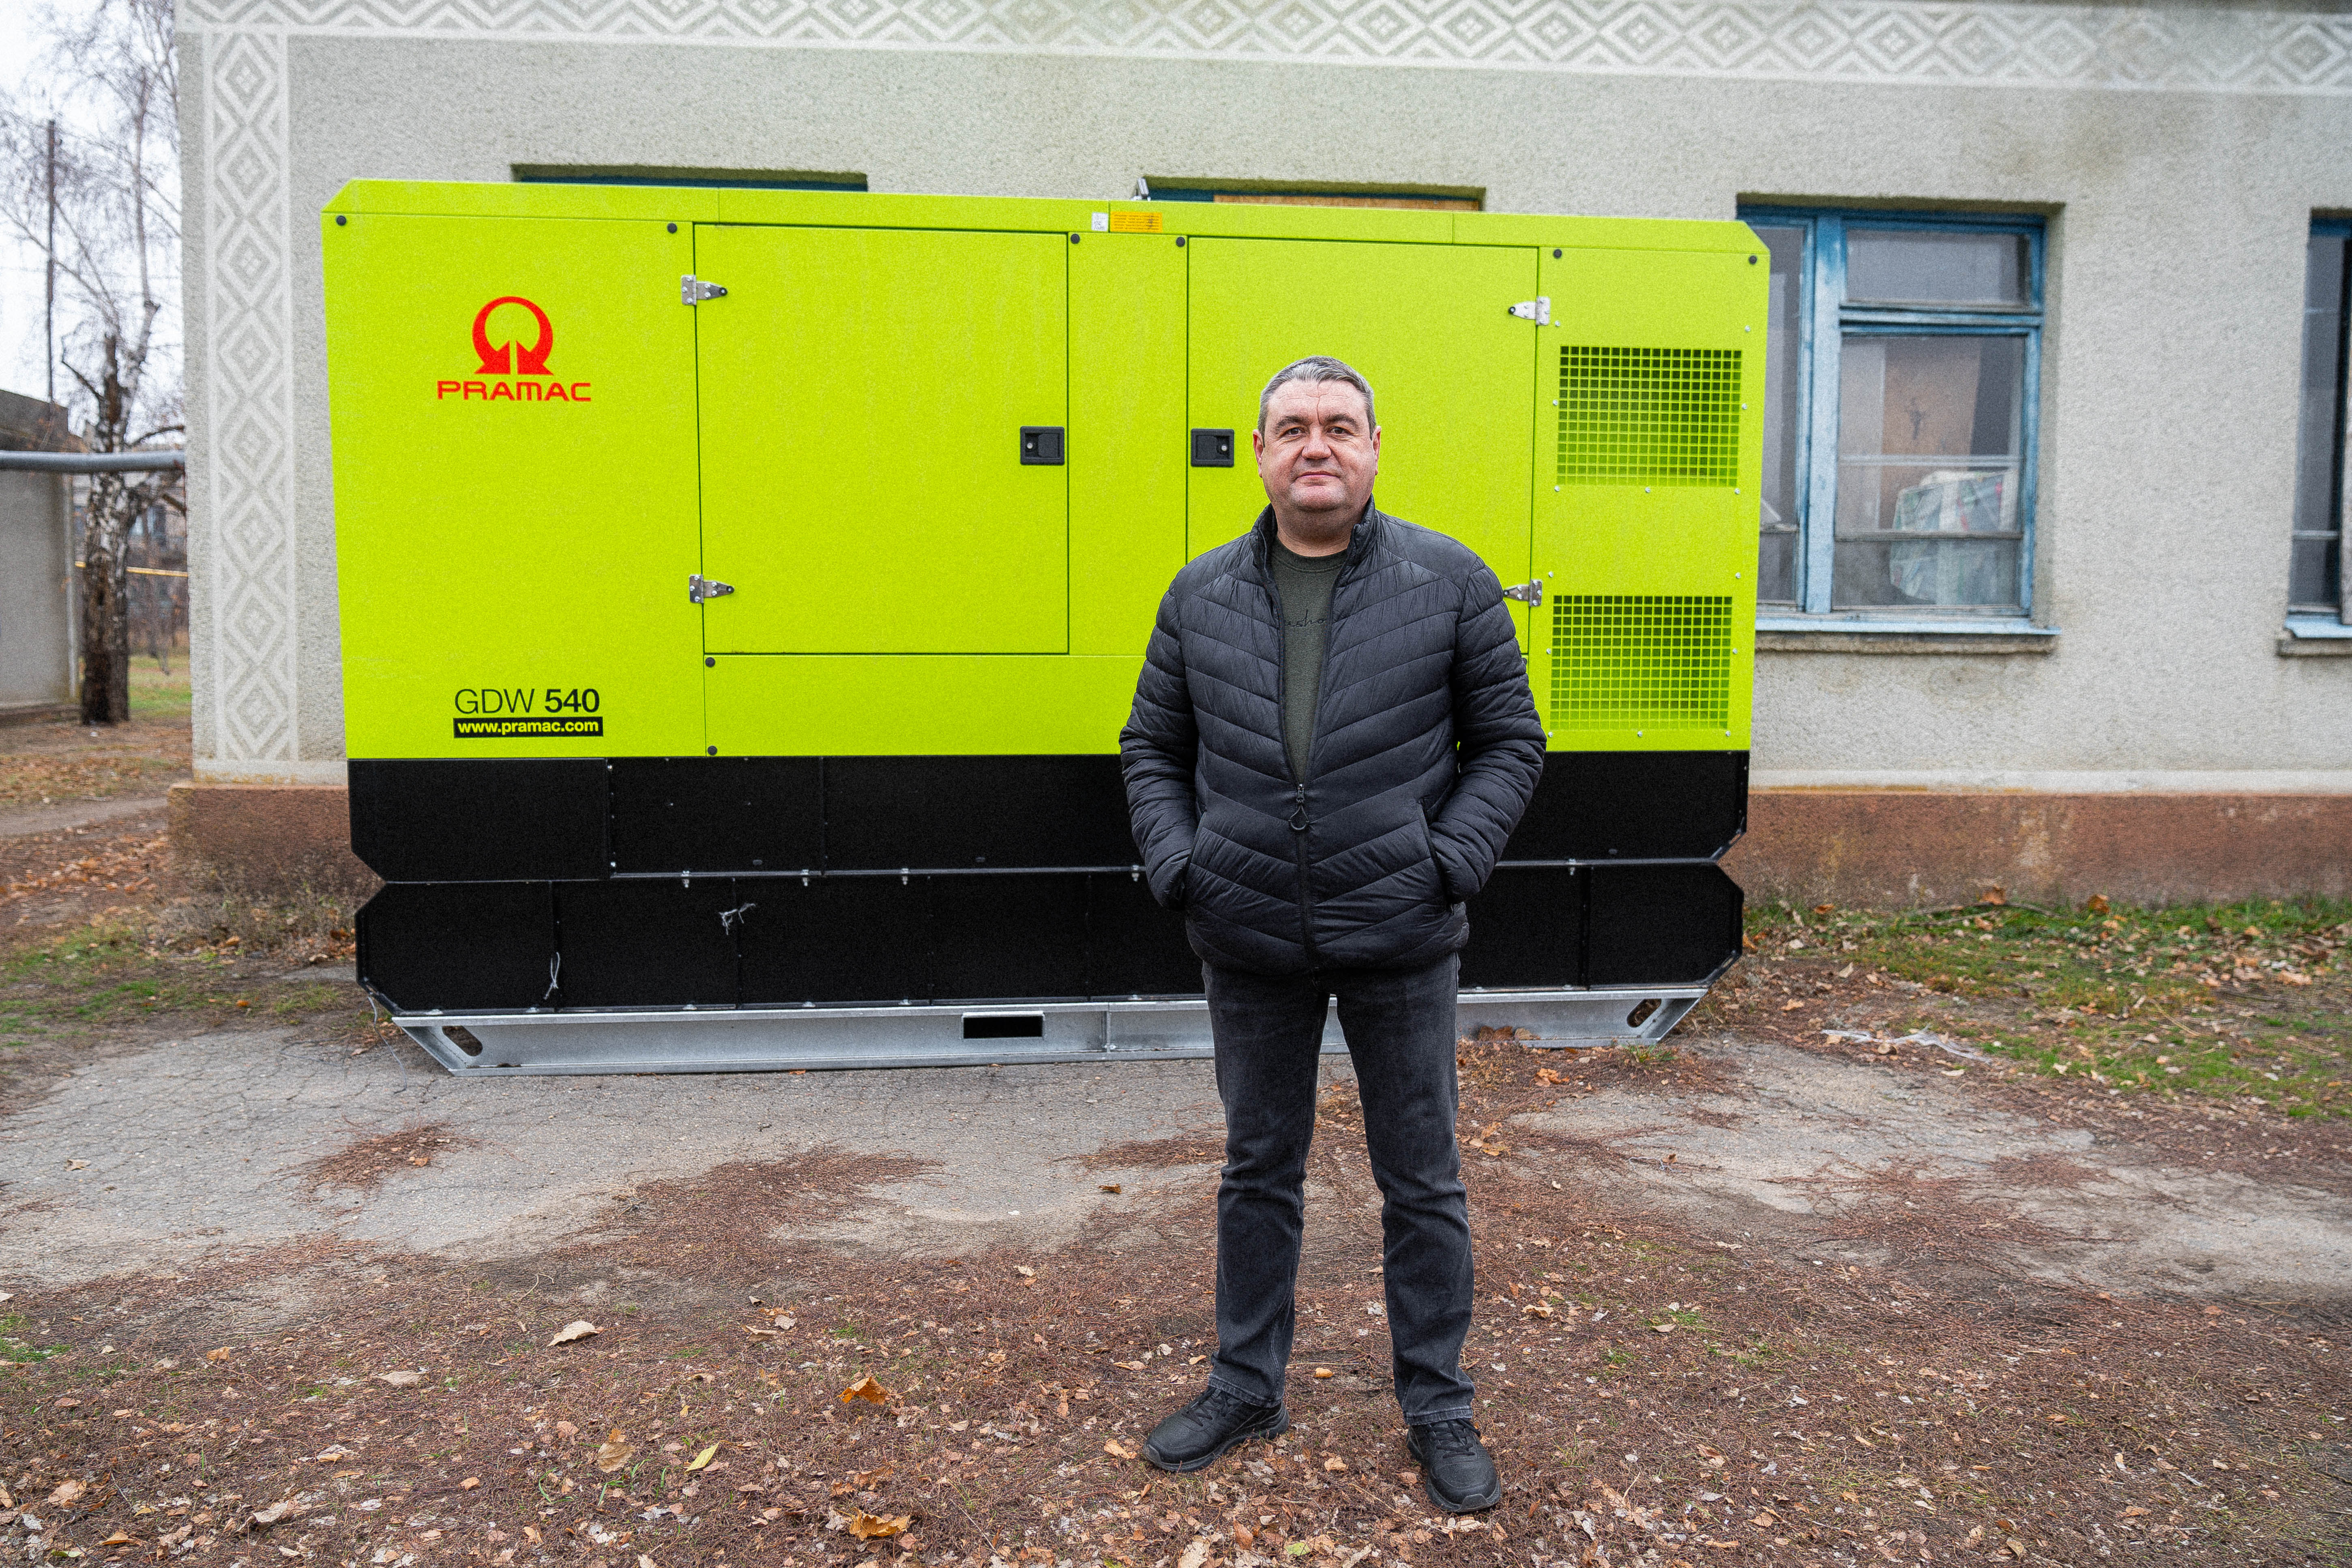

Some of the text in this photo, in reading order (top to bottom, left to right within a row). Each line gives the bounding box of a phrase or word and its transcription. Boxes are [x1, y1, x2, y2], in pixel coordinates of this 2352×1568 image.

[437, 380, 592, 402] PRAMAC
[455, 689, 600, 714] GDW 540
[457, 721, 599, 735] www.pramac.com
